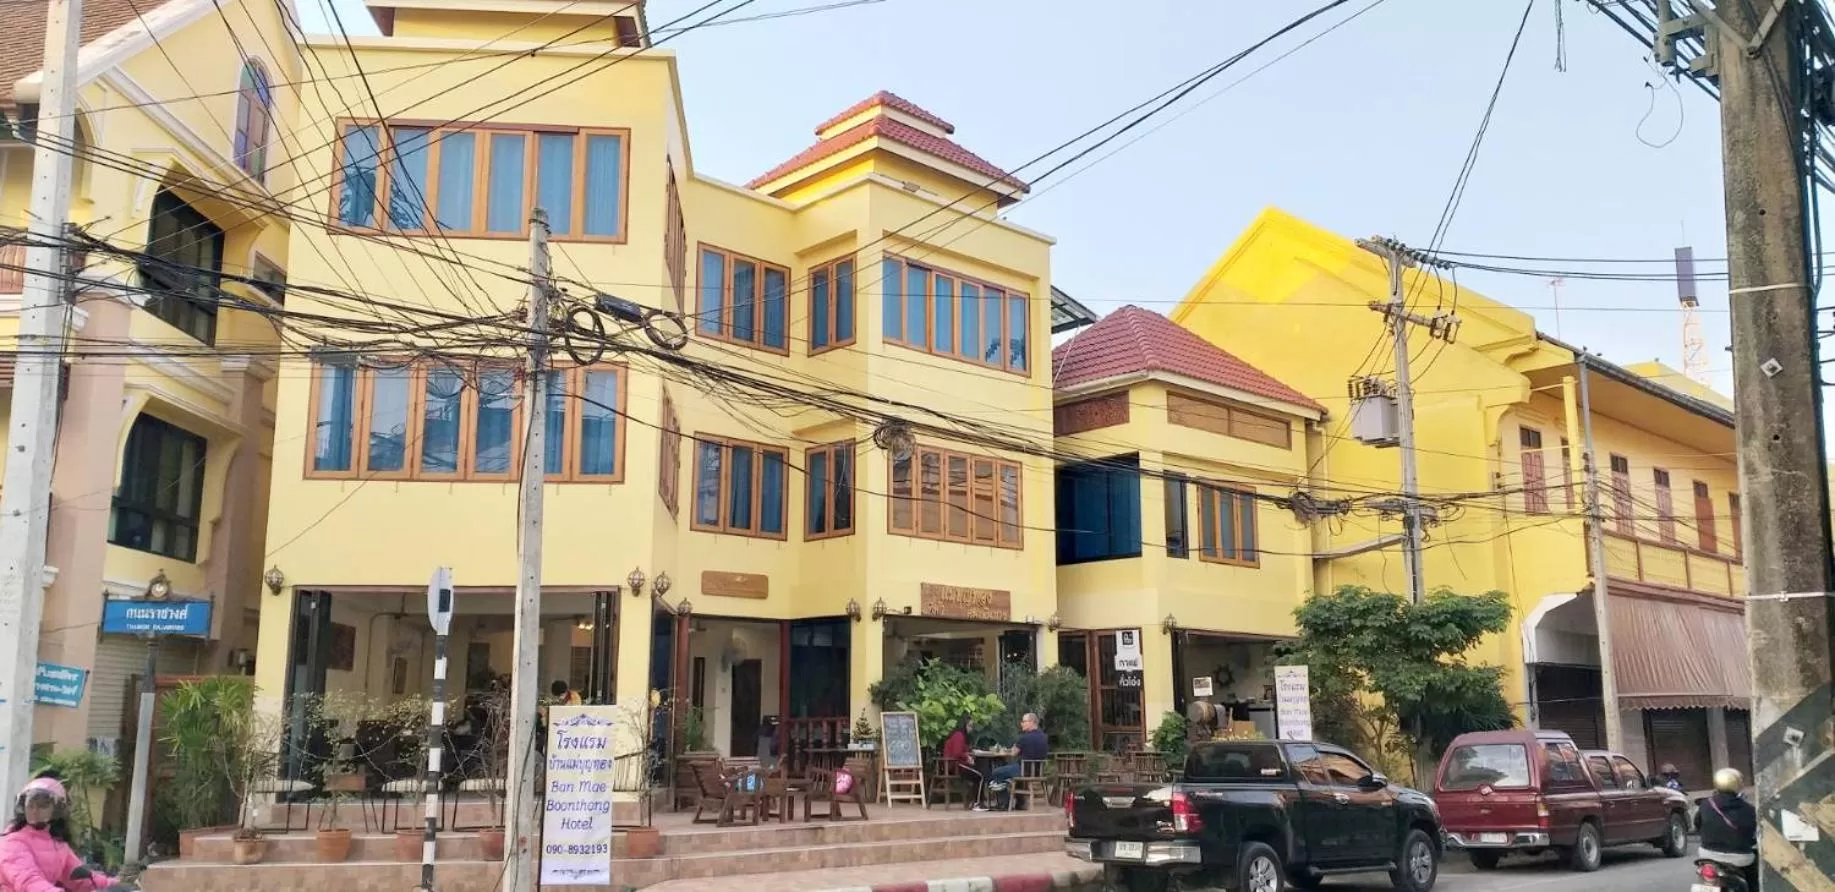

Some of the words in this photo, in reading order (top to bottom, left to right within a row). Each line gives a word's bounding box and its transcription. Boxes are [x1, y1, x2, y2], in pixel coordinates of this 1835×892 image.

[556, 729, 607, 749] โรงแรม
[551, 781, 575, 793] Ban
[578, 780, 608, 793] Mae
[560, 816, 593, 830] Hotel
[546, 844, 608, 855] 090-8932193
